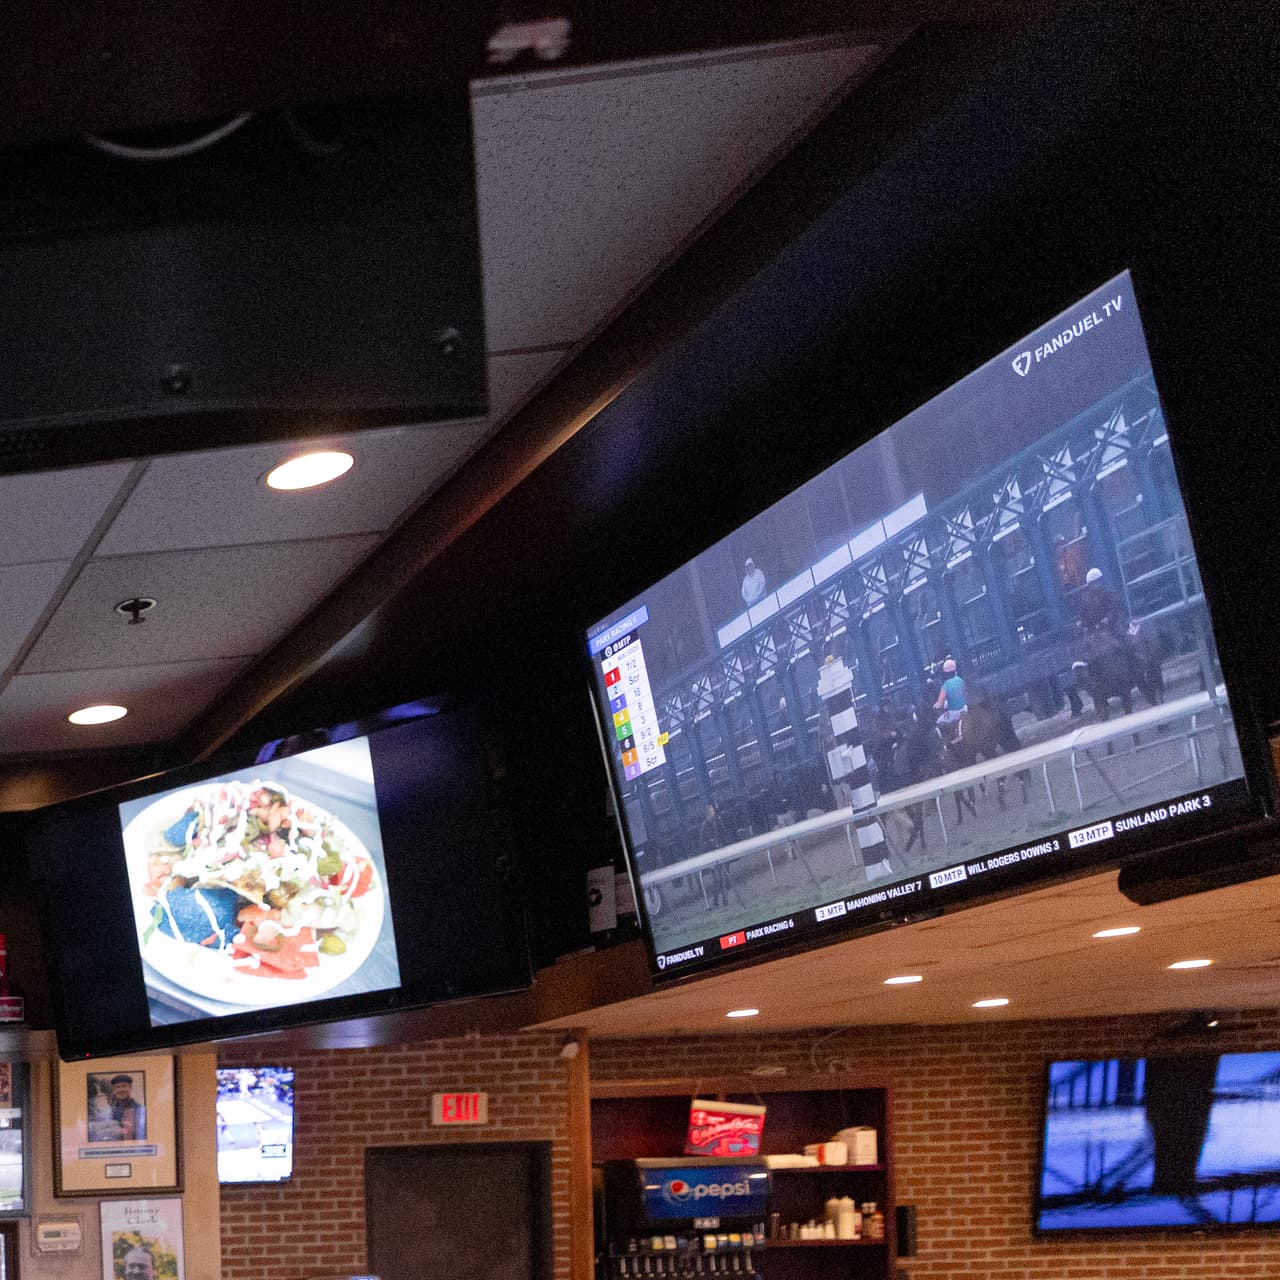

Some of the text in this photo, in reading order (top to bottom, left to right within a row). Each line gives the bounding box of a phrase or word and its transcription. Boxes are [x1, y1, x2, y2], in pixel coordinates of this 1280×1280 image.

[1034, 295, 1122, 363] FANDUEL TV
[1072, 795, 1211, 845] 13 MTP SUNLAND PARK 3
[944, 869, 964, 882] MTP
[967, 863, 987, 877] WILL
[987, 854, 1020, 871] ROGERS
[1020, 845, 1052, 862] DOWNS
[1052, 840, 1060, 851] 3
[827, 903, 844, 917] MTP
[846, 891, 887, 910] MAHONING
[886, 884, 915, 900] VALLEY
[915, 881, 922, 891] 7
[728, 935, 738, 945] PT
[764, 921, 788, 936] RACING
[666, 946, 704, 966] FANDUEL TV
[442, 1093, 480, 1122] EXIT
[694, 1180, 751, 1200] pepsi
